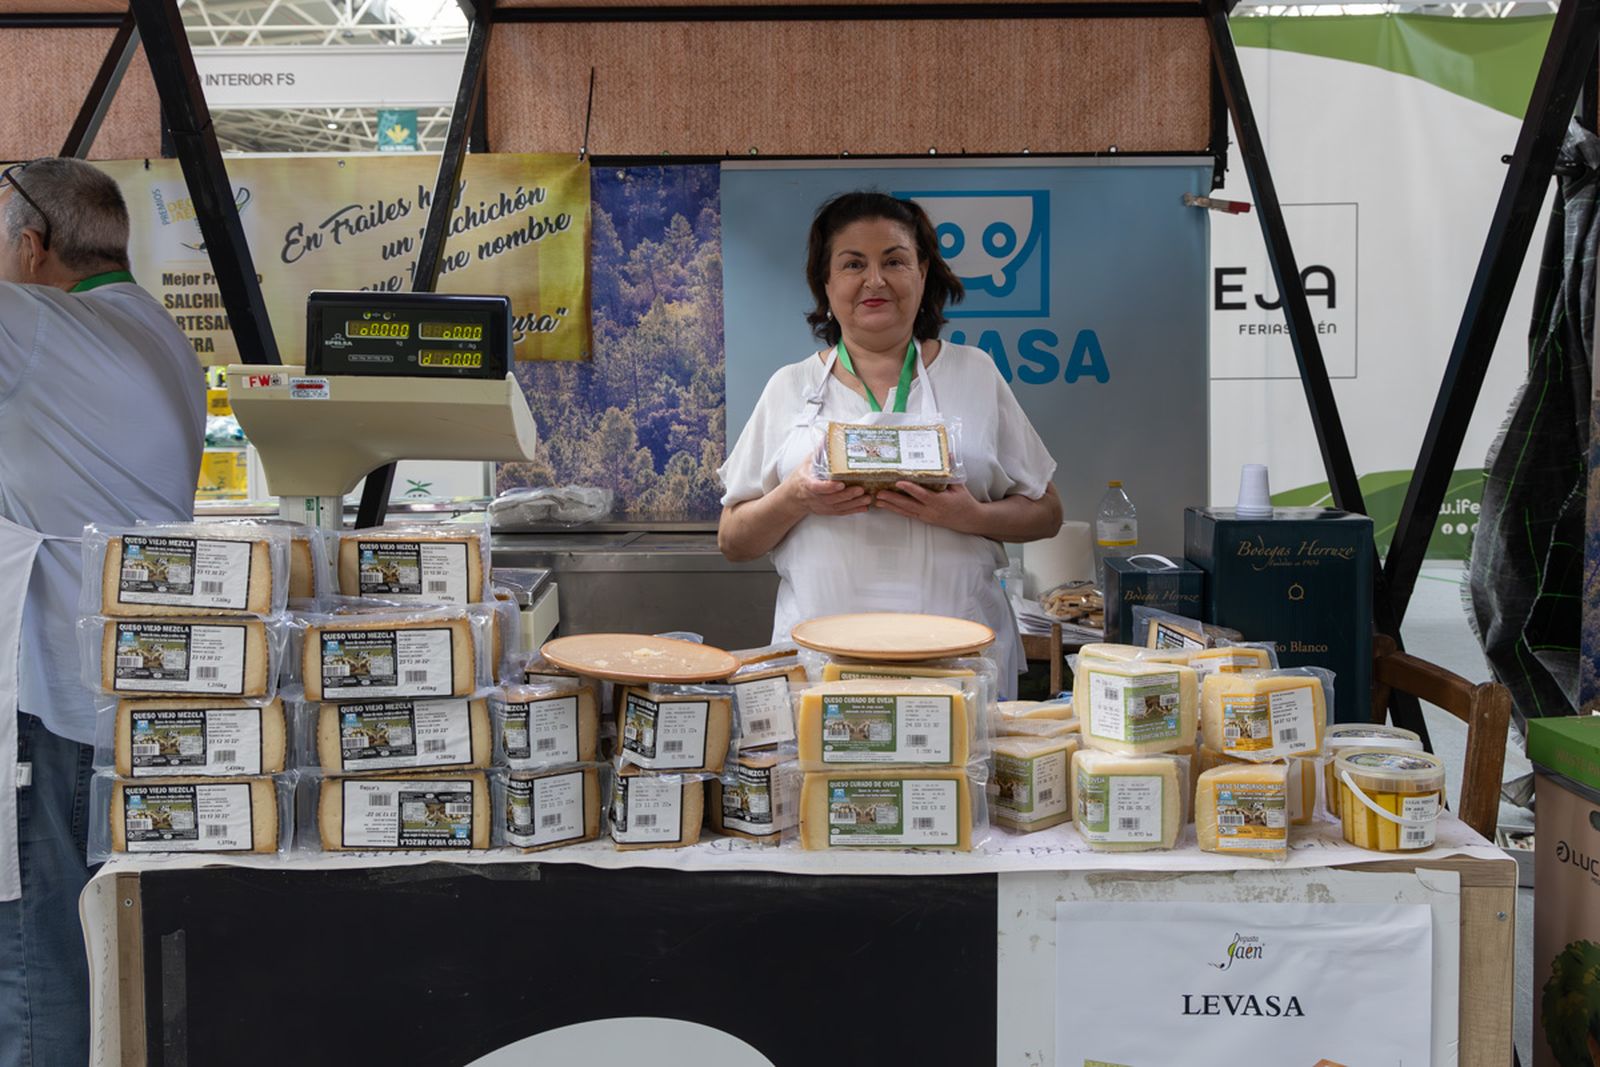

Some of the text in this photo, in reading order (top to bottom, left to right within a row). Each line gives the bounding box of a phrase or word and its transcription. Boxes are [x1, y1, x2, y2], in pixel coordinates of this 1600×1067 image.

[205, 73, 296, 86] INTERIOR FS
[281, 222, 324, 264] En
[318, 197, 412, 245] Frailes
[477, 212, 571, 261] nombre
[382, 237, 414, 261] un
[162, 273, 200, 286] Mejor
[164, 293, 226, 309] SALCHI
[950, 328, 1111, 385] ASA
[248, 374, 271, 388] FW
[124, 536, 195, 548] QUESO VIEJO MEZCLA
[1237, 536, 1292, 568] Bodegas
[1296, 539, 1356, 560] Herruzo
[119, 624, 142, 632] QUESO
[1290, 640, 1329, 653] Blanco
[340, 702, 412, 714] QUESO VIEJO MEZCLA
[125, 787, 147, 795] QUESO
[1182, 994, 1306, 1017] LEVASA
